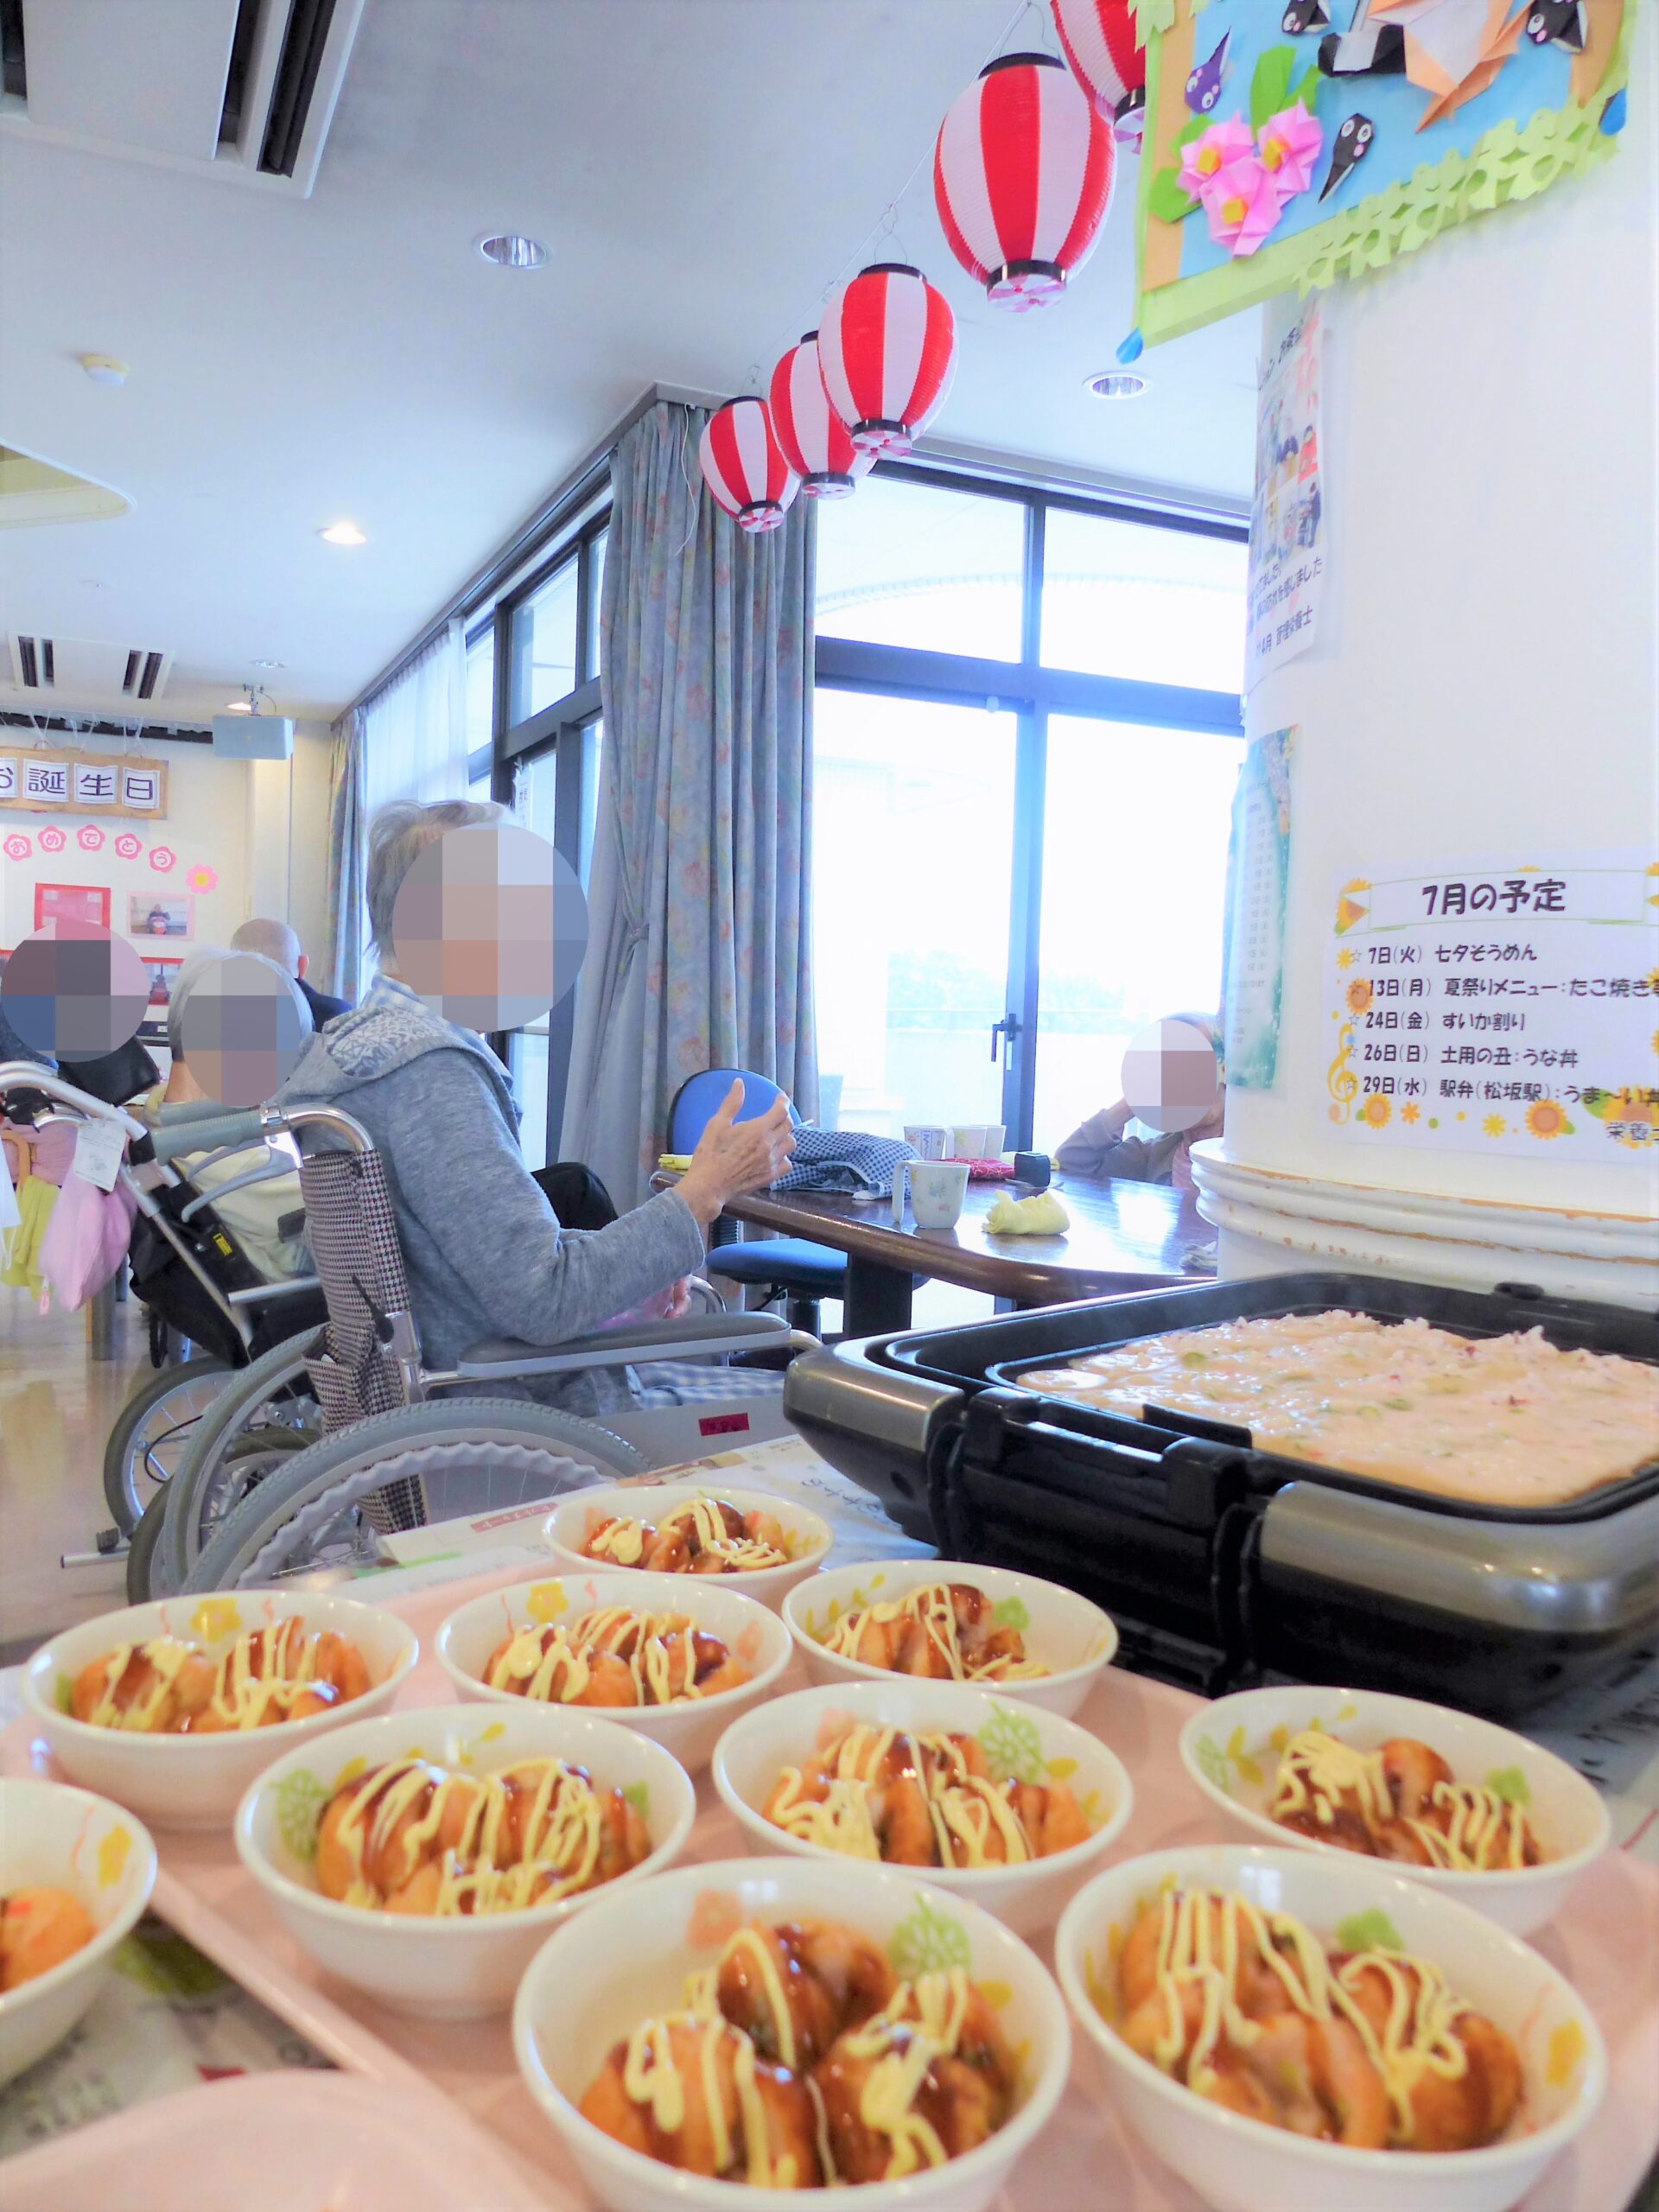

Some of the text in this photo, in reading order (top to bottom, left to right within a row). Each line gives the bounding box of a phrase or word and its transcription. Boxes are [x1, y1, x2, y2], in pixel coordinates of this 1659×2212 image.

[10, 832, 168, 865] おめでとう
[1422, 878, 1566, 916] 7月の予定
[1434, 944, 1538, 963] 七夕そうめん
[1442, 1013, 1526, 1032] すいか割り
